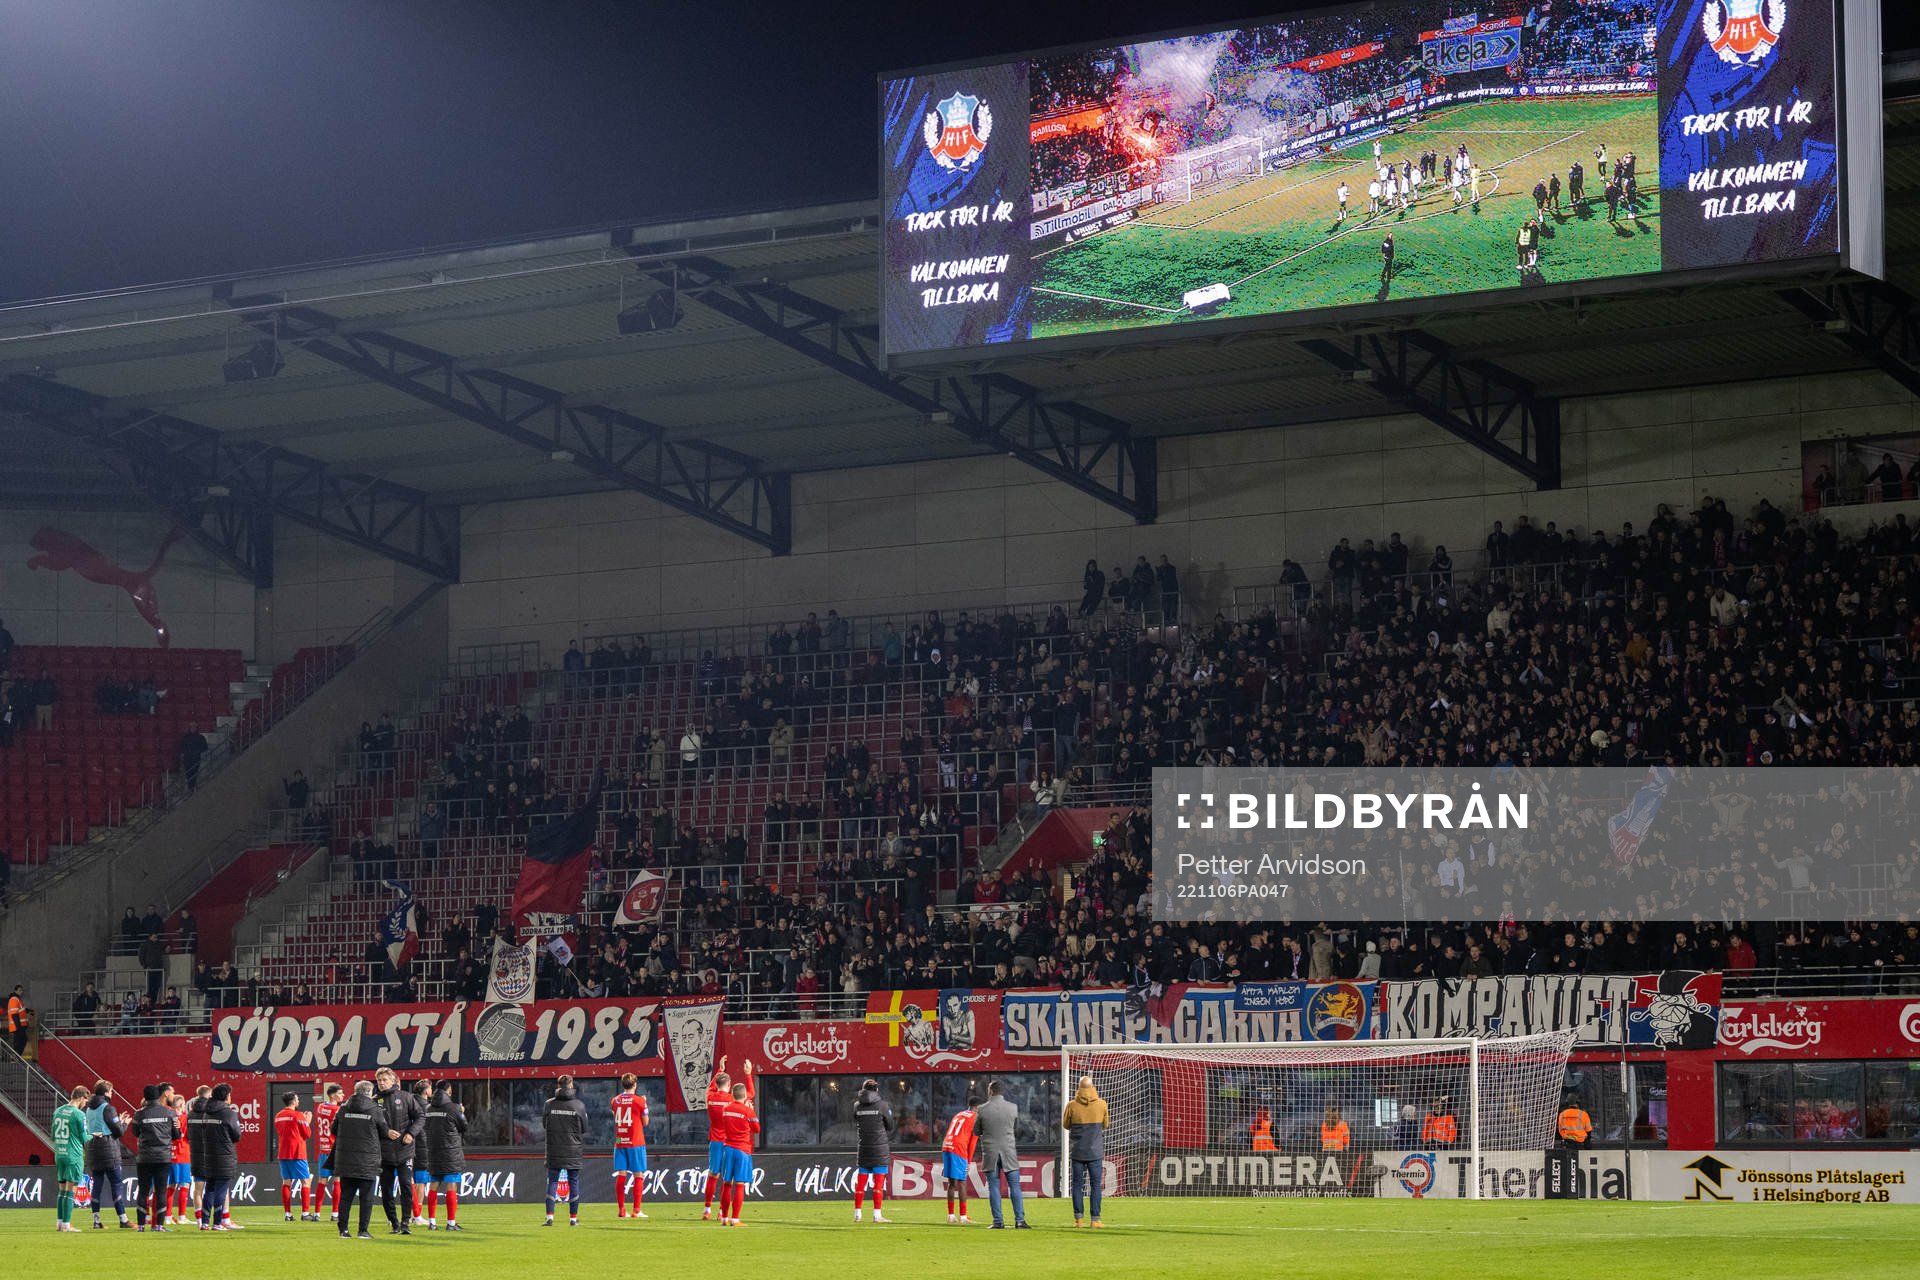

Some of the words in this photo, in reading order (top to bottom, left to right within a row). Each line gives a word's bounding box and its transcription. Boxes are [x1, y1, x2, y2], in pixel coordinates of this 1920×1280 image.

[1680, 112, 1730, 136] TACK
[1774, 105, 1782, 124] I
[1701, 190, 1796, 219] TILLBAKA
[905, 210, 946, 232] TACK
[982, 205, 989, 222] I
[1044, 208, 1091, 234] Tillmobil
[921, 282, 999, 308] TILLBAKA
[962, 995, 987, 1003] CHOOSE
[1388, 976, 1635, 1043] KOMPANIET
[212, 1006, 364, 1070] SÖDRA
[377, 1002, 464, 1065] STÅ
[530, 1004, 659, 1060] 1985
[1718, 1007, 1823, 1046] Carlsberg
[763, 1026, 850, 1063] Carlsberg
[54, 1117, 70, 1139] 25
[317, 1117, 331, 1137] 33
[615, 1107, 633, 1127] 44
[948, 1118, 965, 1135] 11
[1161, 1156, 1343, 1185] OPTIMERA
[1391, 1169, 1425, 1179] Thermia
[1552, 1158, 1561, 1193] SELECT
[1737, 1169, 1812, 1183] Jönssons
[1816, 1169, 1905, 1188] Plåtslageri
[231, 1172, 256, 1202] ÅR
[1753, 1188, 1760, 1201] i
[1762, 1188, 1861, 1203] Helsingborg
[1865, 1189, 1889, 1202] AB
